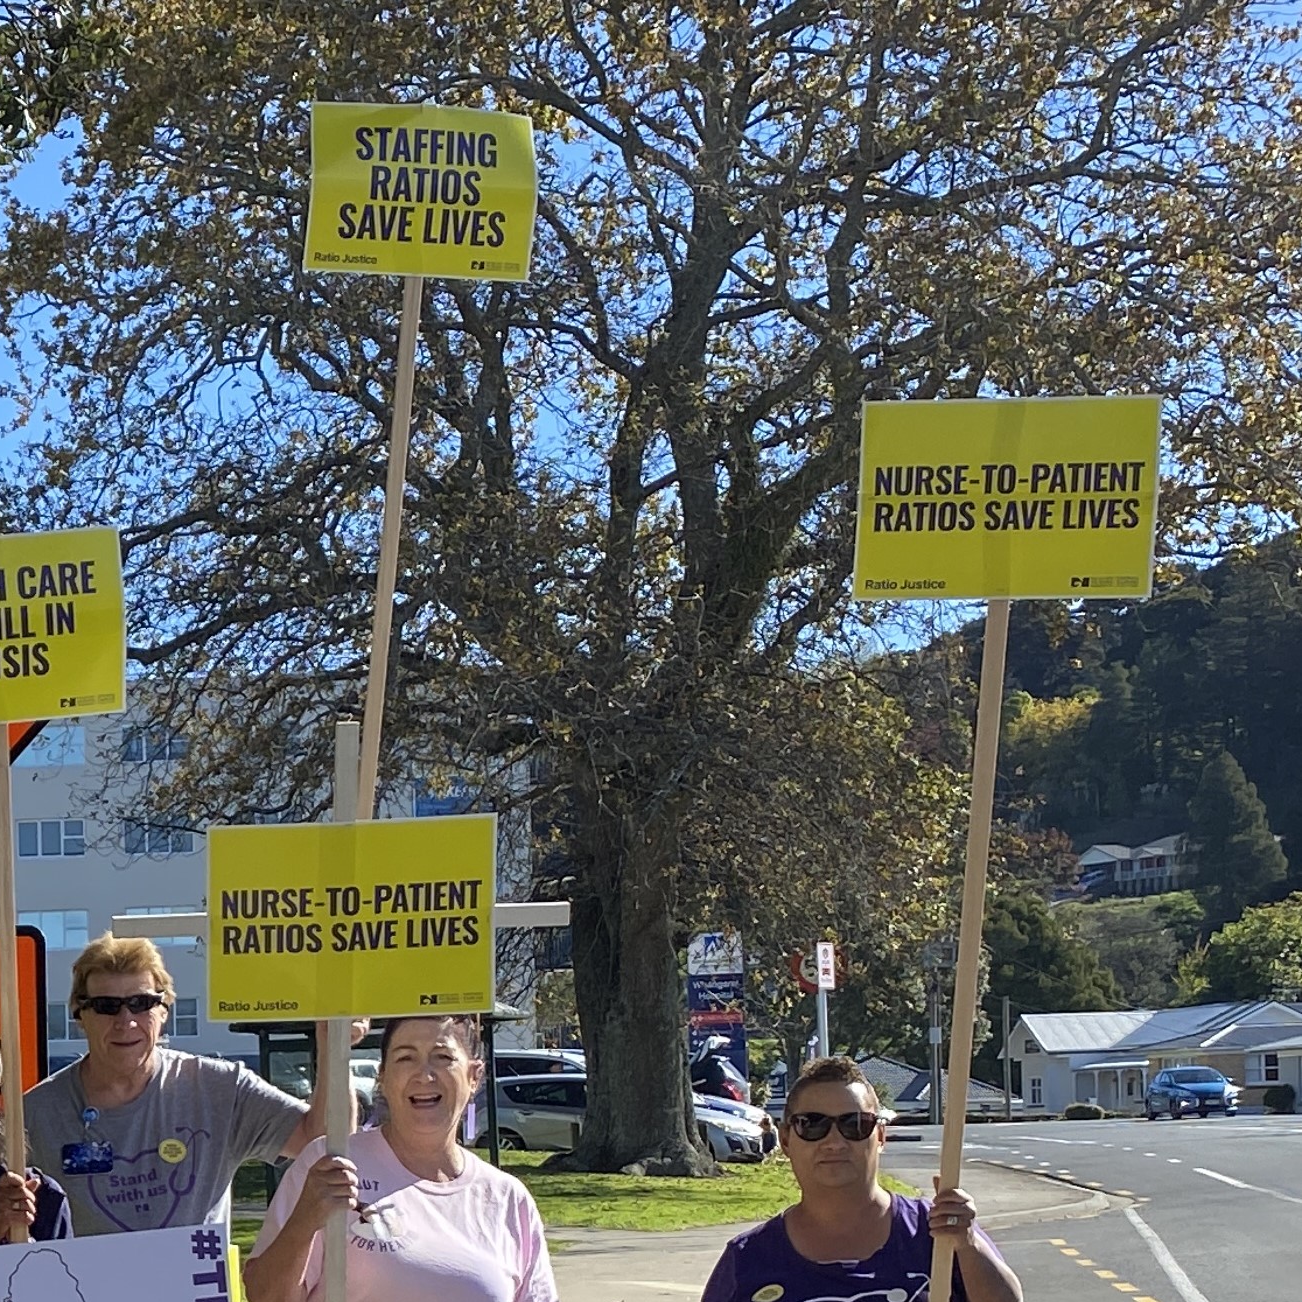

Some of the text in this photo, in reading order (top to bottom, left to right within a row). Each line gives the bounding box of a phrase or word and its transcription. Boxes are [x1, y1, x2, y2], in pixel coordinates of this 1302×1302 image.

[355, 127, 497, 168] STAFFING
[370, 165, 481, 207] RATIOS
[338, 203, 506, 247] SAVE LIVES
[314, 251, 378, 265] Ratio Justice
[874, 461, 1145, 496] NURSE-TO-PATIENT
[873, 498, 1140, 532] RATIOS SAVE LIVES
[17, 561, 96, 600] CARE
[865, 578, 946, 590] Ratio Justice
[45, 601, 75, 636] IN
[221, 880, 483, 919] NURSE-TO-PATIENT
[222, 916, 479, 955] RATIOS SAVE LIVES
[219, 1000, 298, 1012] Ratio Justice
[106, 1184, 168, 1204] with us
[109, 1168, 157, 1188] Stand
[351, 1235, 375, 1251] FOR
